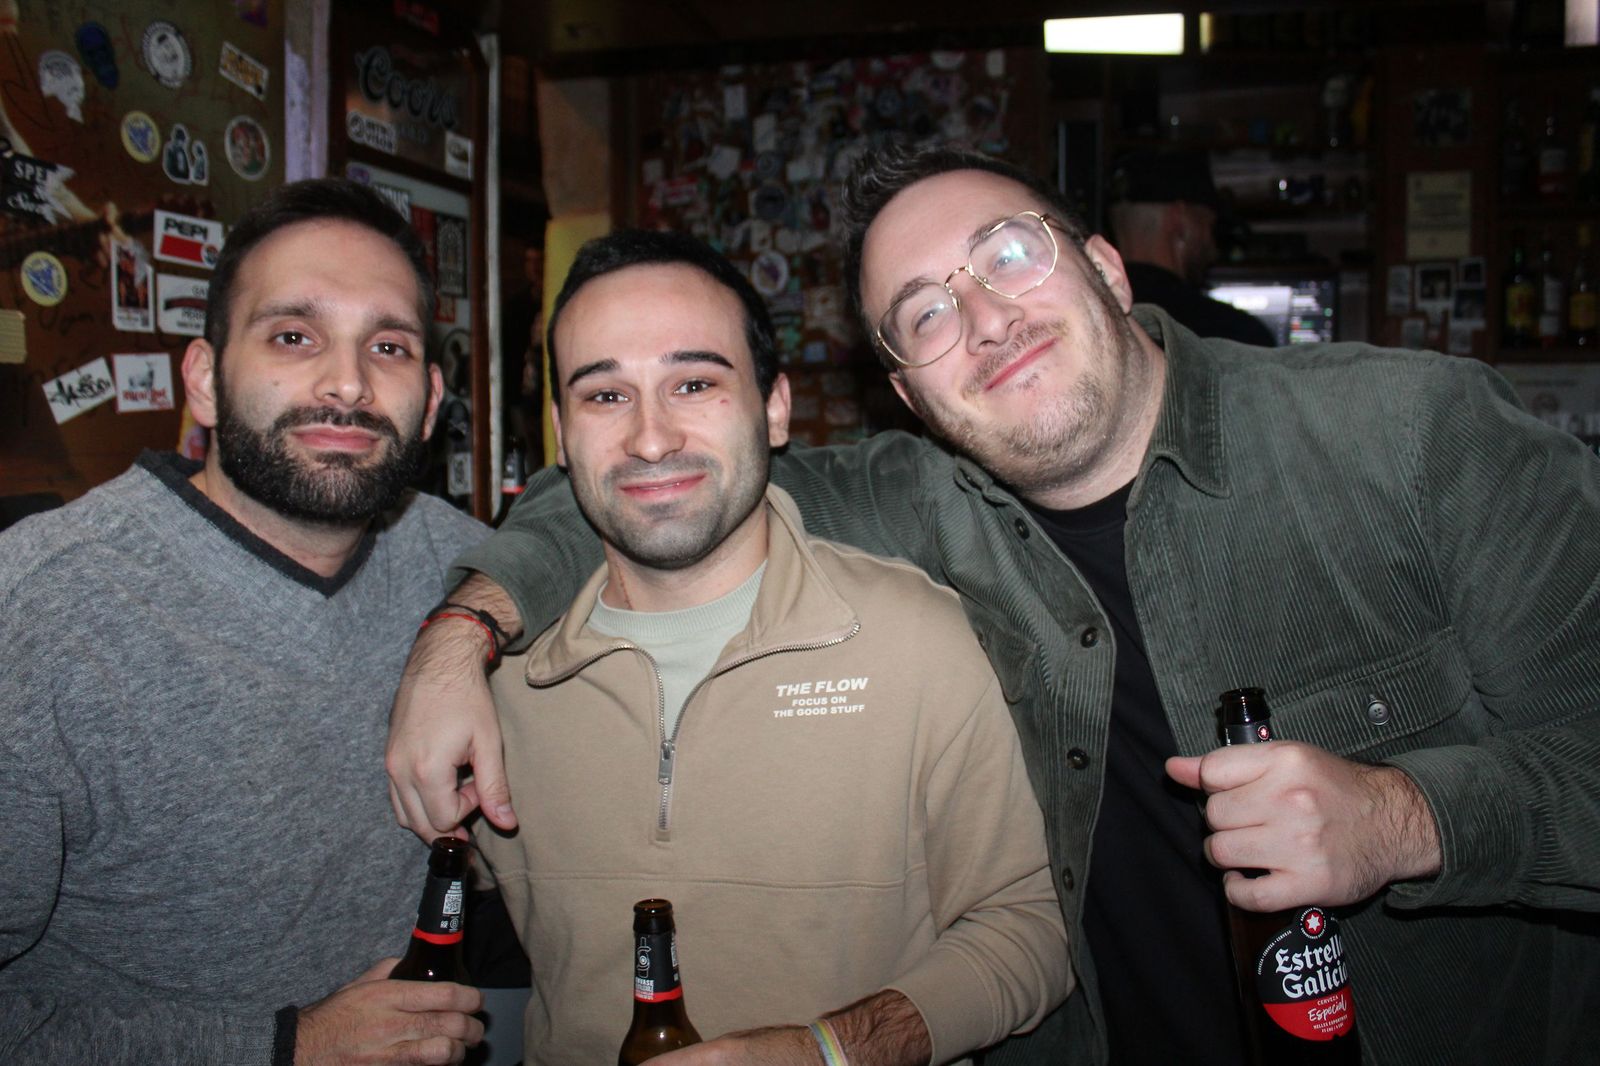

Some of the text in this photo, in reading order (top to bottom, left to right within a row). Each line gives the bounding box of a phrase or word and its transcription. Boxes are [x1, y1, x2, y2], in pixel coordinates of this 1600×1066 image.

[776, 677, 869, 697] THE FLOW
[792, 695, 847, 707] FOCUS ON
[773, 704, 865, 718] THE GOOD STUFF
[1308, 994, 1347, 1021] Especial
